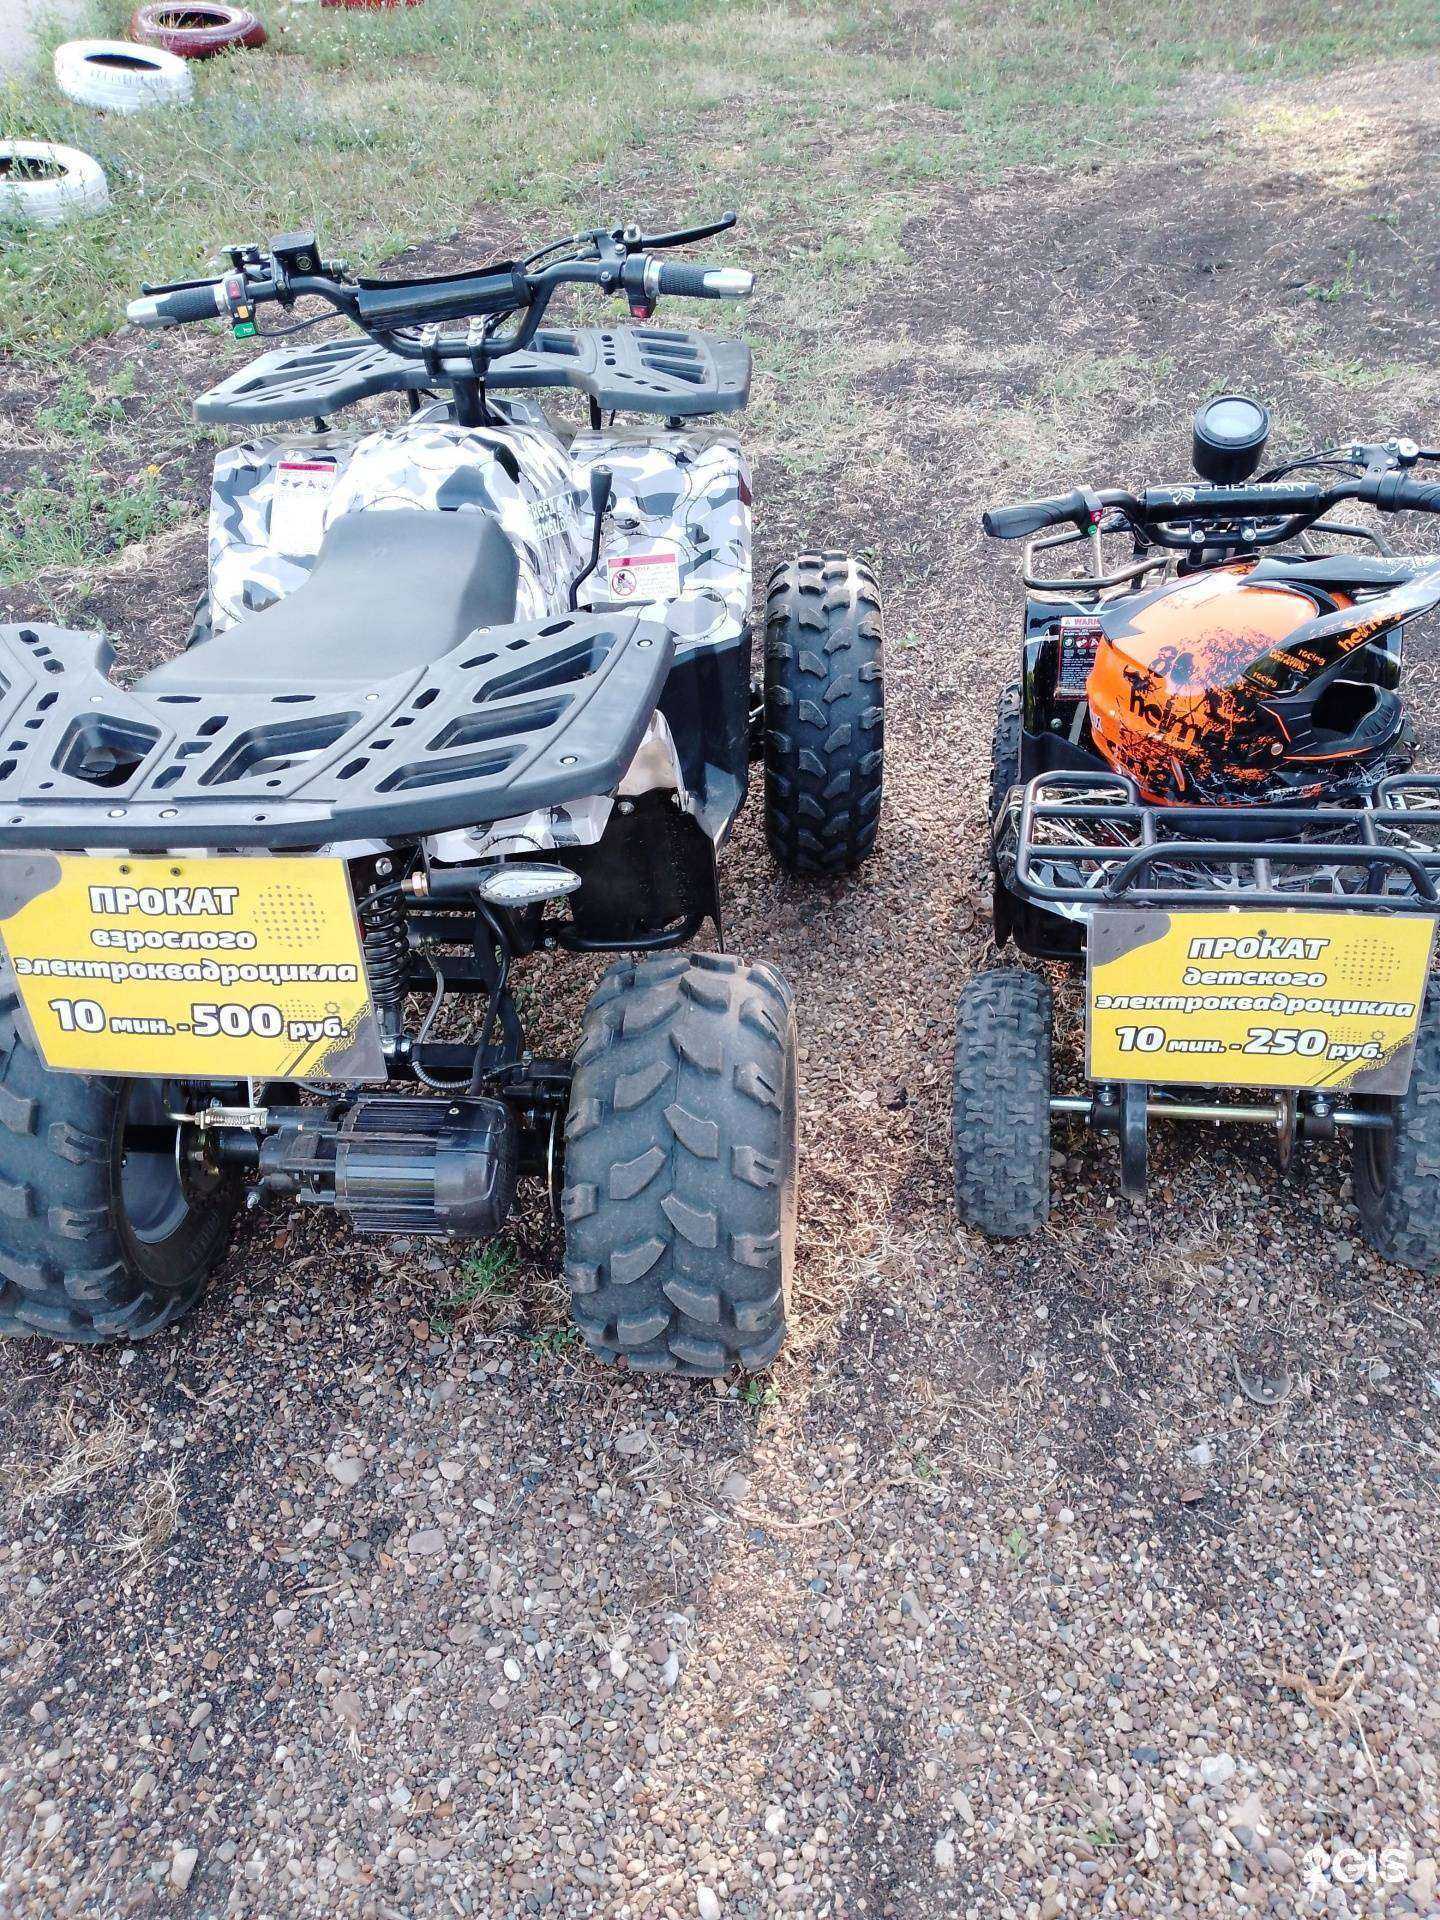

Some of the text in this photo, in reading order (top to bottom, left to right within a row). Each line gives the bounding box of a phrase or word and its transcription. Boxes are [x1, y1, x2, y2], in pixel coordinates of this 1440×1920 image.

[88, 885, 240, 916] ПРОКАТ
[90, 929, 258, 952] взрослого
[1187, 936, 1330, 960] ПРОКАТ
[13, 956, 358, 986] электроквадроцикла
[1182, 966, 1328, 988] детского
[1095, 993, 1416, 1018] электроквадроцикла
[48, 998, 105, 1033] 10
[286, 1015, 349, 1043] руб.
[1115, 1025, 1166, 1052] 10
[1326, 1043, 1385, 1062] руб.
